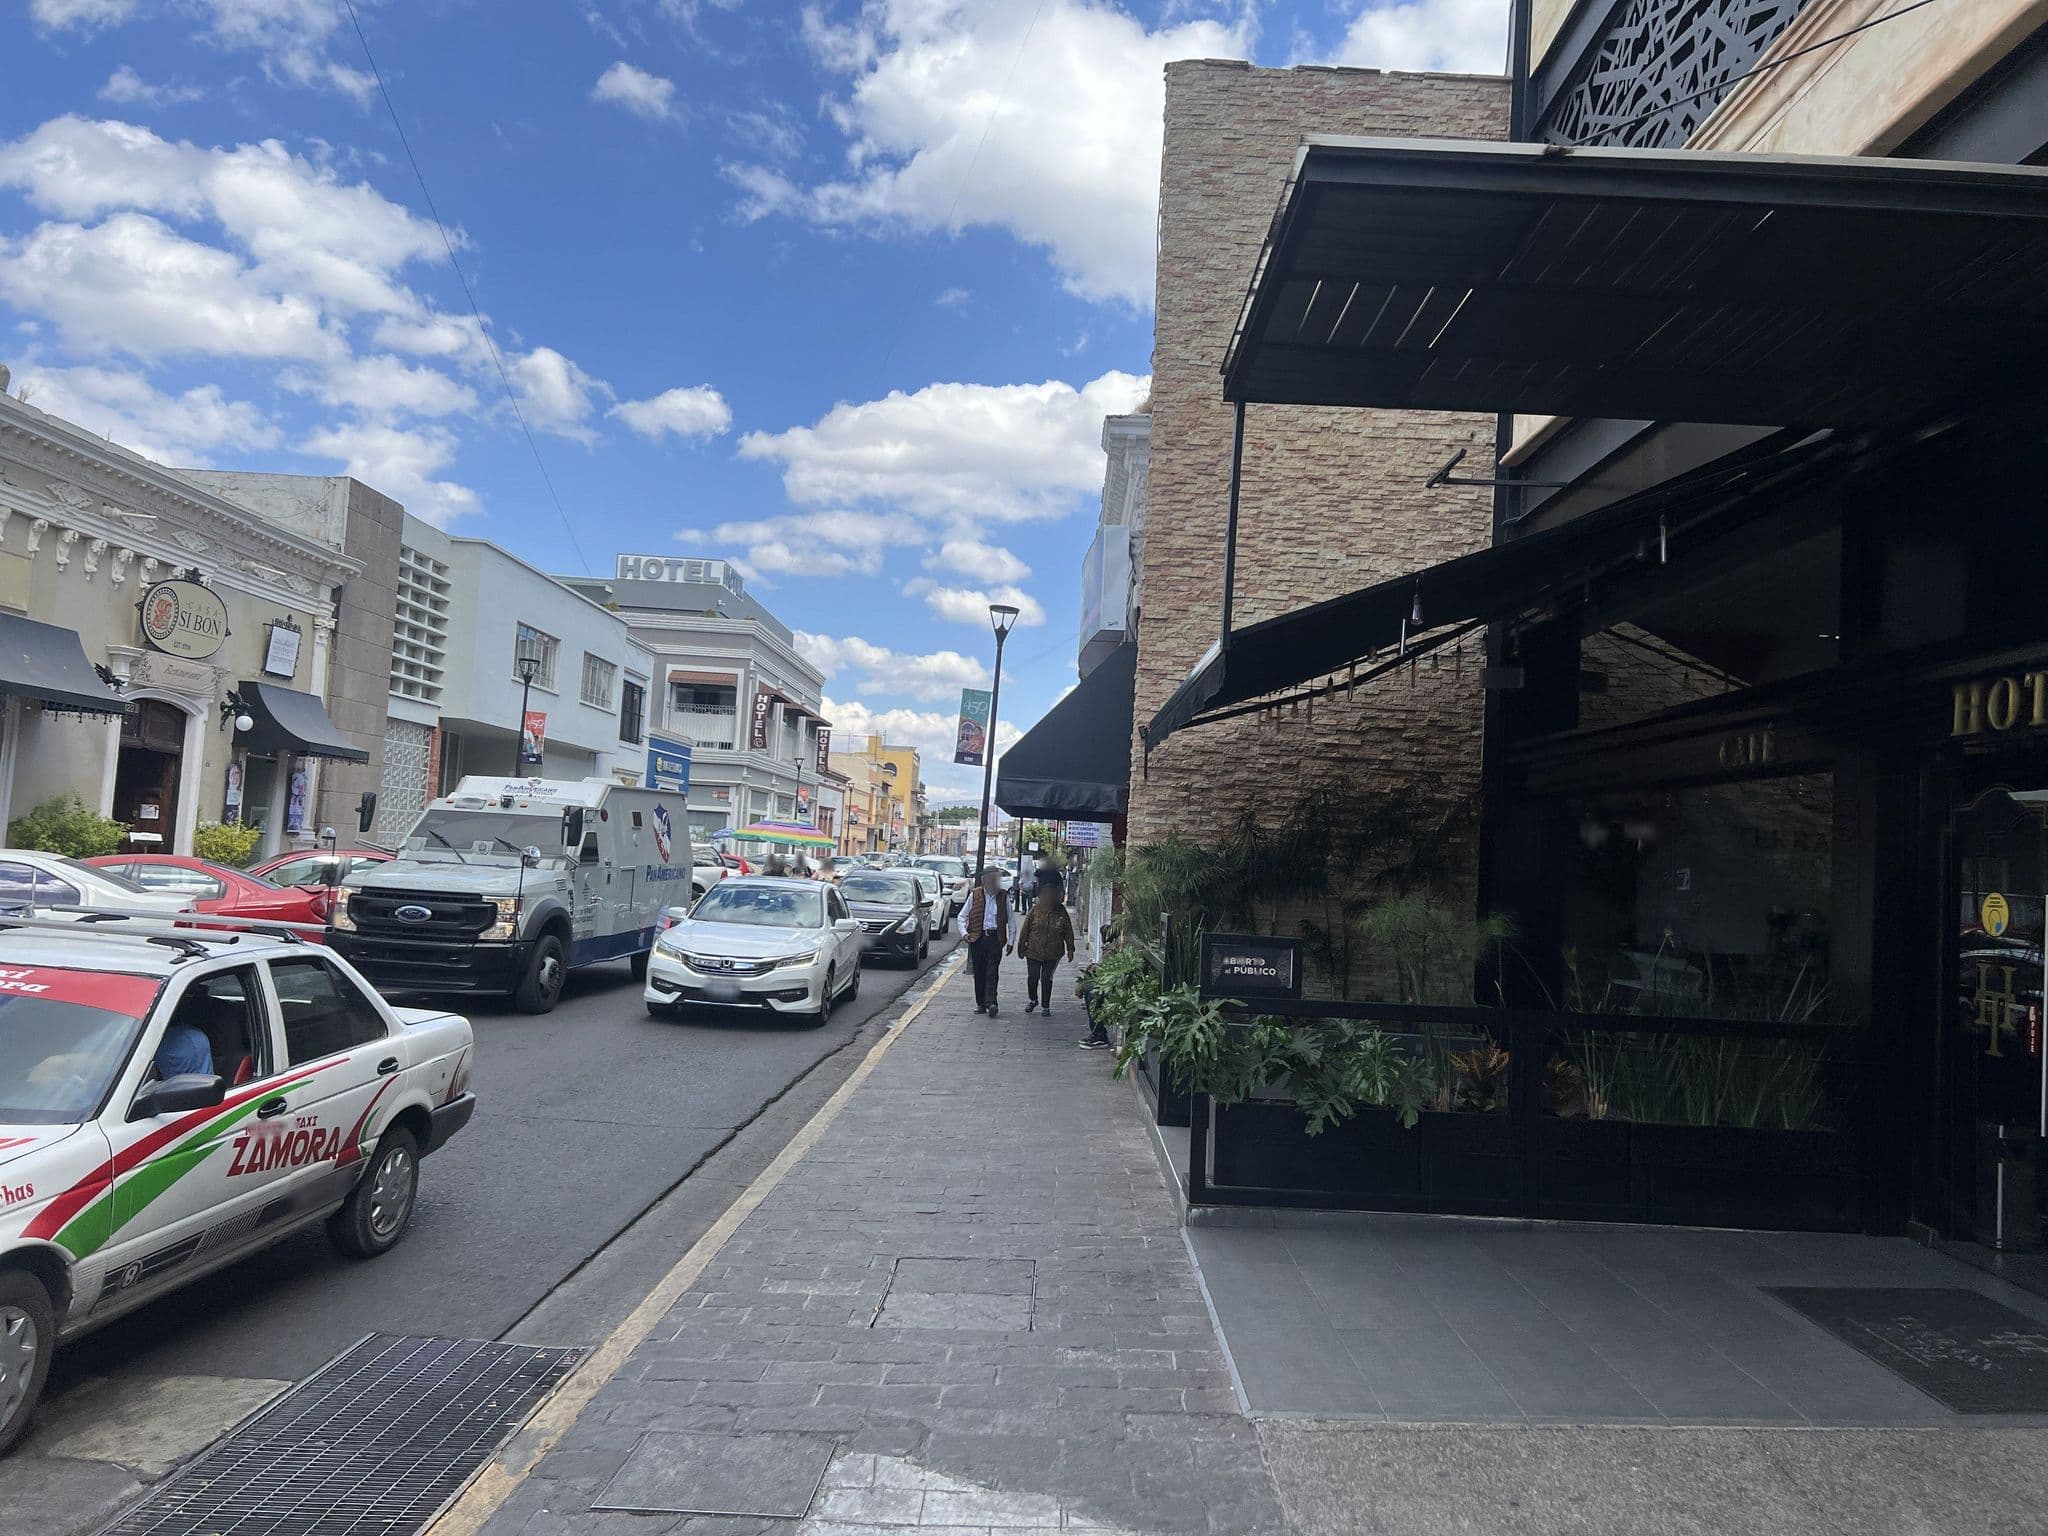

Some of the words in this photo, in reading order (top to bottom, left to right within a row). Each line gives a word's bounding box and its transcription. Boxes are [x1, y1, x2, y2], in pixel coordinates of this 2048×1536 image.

[620, 556, 721, 584] HOTEL
[187, 601, 221, 618] CASA
[178, 611, 192, 629] SI
[193, 615, 222, 637] BON
[754, 694, 768, 737] HOTEL
[963, 700, 988, 715] 450
[1950, 671, 2048, 737] HOT
[818, 730, 829, 764] HOTEL
[296, 1115, 318, 1128] TAXI
[226, 1126, 340, 1178] ZAMORA
